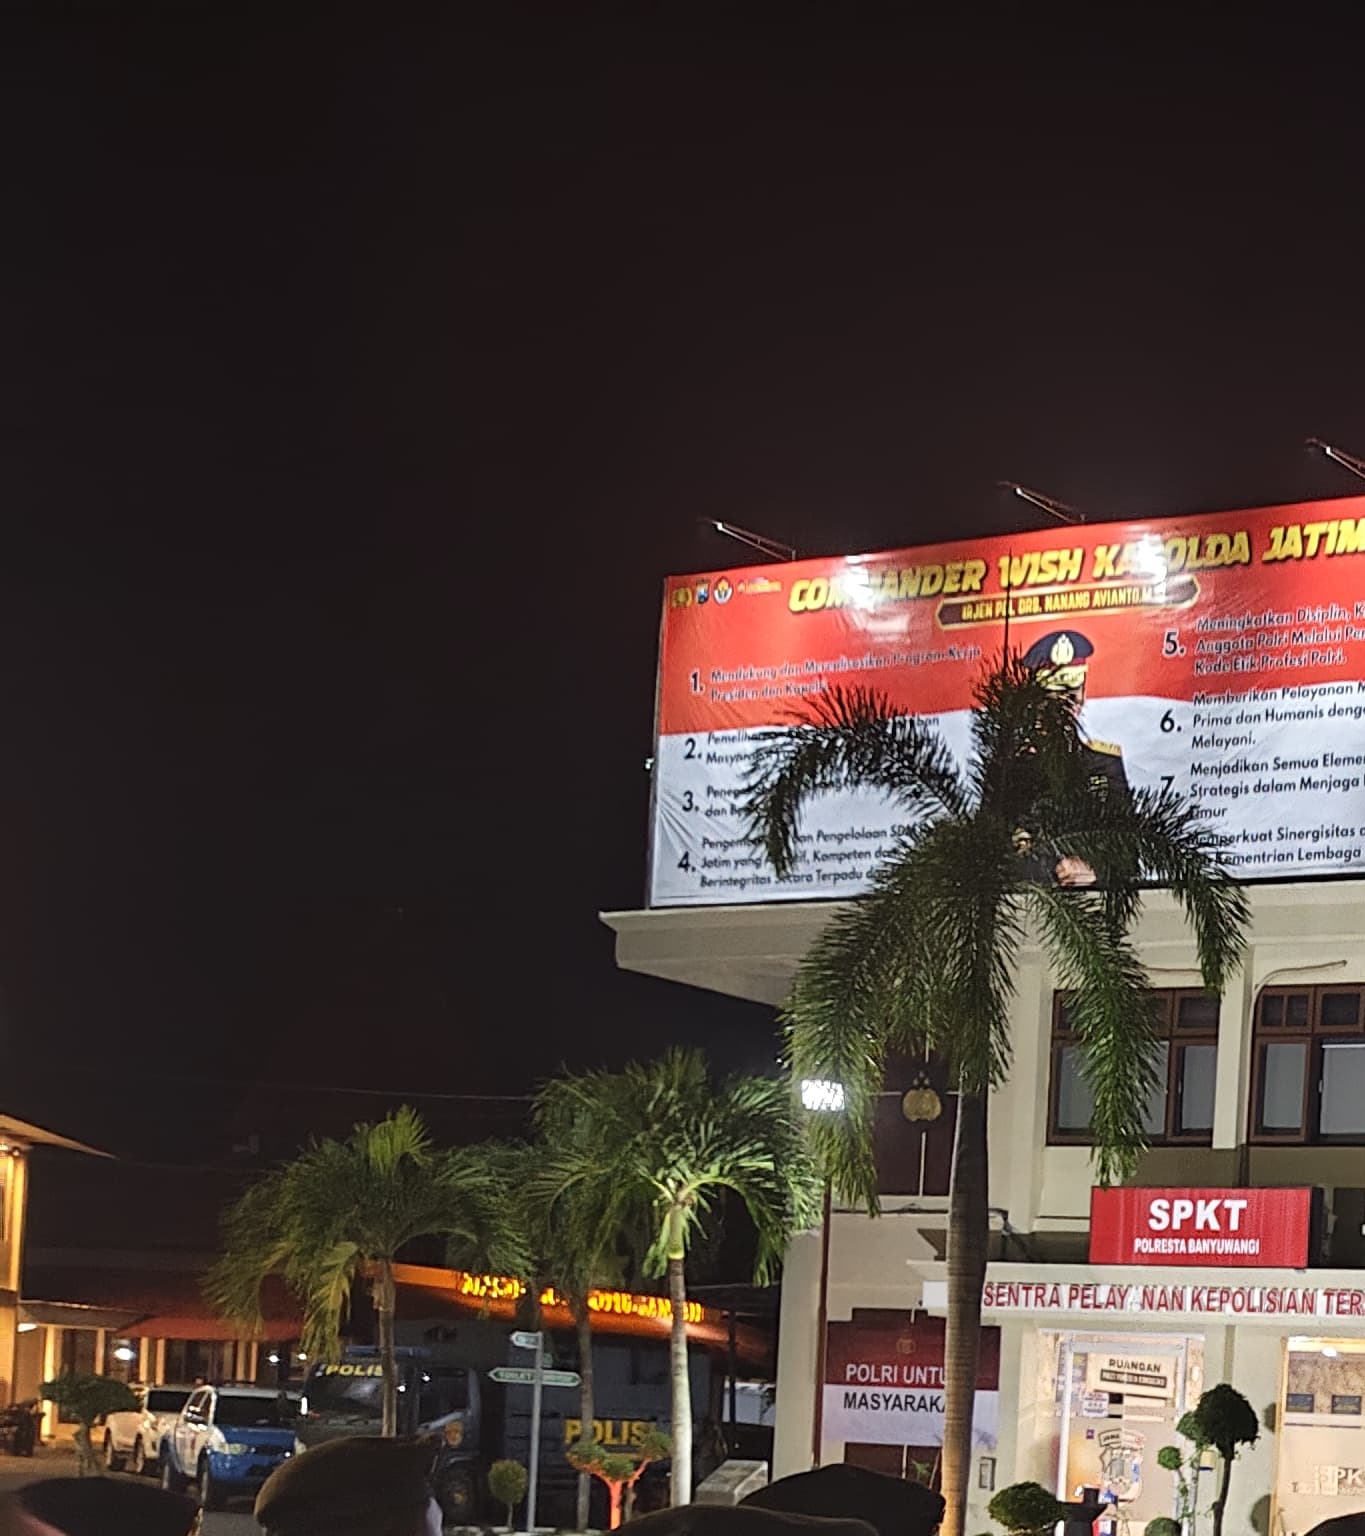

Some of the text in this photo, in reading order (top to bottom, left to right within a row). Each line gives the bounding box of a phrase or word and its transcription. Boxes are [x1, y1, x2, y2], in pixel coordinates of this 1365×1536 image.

[789, 559, 987, 612] COMANDER
[999, 548, 1083, 588] WISH
[1093, 531, 1250, 578] KAOLDA
[1163, 629, 1186, 655] 5.
[1195, 610, 1293, 632] Meningkatkan
[1196, 638, 1254, 655] Anggota
[1257, 633, 1289, 648] Polri
[1291, 627, 1341, 645] Melalui
[1194, 659, 1229, 675] Kode
[1233, 656, 1258, 672] Etik
[1261, 652, 1307, 671] Profesi
[690, 669, 705, 694] 1.
[710, 664, 776, 684] Mendukung
[1159, 708, 1182, 733] 6.
[1193, 687, 1278, 706] Memberikan
[1281, 682, 1353, 701] Pelayanan
[1193, 712, 1232, 728] Prima
[1236, 709, 1261, 724] dan
[1265, 705, 1324, 722] Humanis
[684, 737, 702, 760] 2.
[1191, 730, 1256, 751] Melayani.
[1159, 775, 1181, 800] 7.
[1190, 758, 1269, 779] Menjadikan
[1272, 756, 1319, 772] Semua
[1189, 780, 1250, 800] Strategis
[1253, 777, 1296, 794] dalam
[1299, 774, 1360, 794] Menjaga
[682, 790, 700, 812] 3.
[704, 803, 727, 817] dan
[816, 825, 888, 845] Pengelolaan
[1276, 822, 1356, 843] Sinergisitas
[677, 851, 696, 873] 4.
[701, 854, 731, 869] Jatim
[733, 854, 762, 871] yang
[813, 848, 871, 865] Kompeten
[1297, 846, 1361, 863] Lembaga
[700, 870, 772, 889] Berintegritas
[816, 866, 863, 886] Terpadu
[1148, 1198, 1248, 1231] SPKT
[1133, 1237, 1261, 1256] POLRESTA BANYUWANGI
[983, 1284, 1061, 1308] SENTRA
[1190, 1287, 1317, 1315] KEPOLISIAN
[325, 1363, 384, 1377] POLIS
[845, 1363, 898, 1384] POLRI
[843, 1391, 946, 1414] MASYARAK
